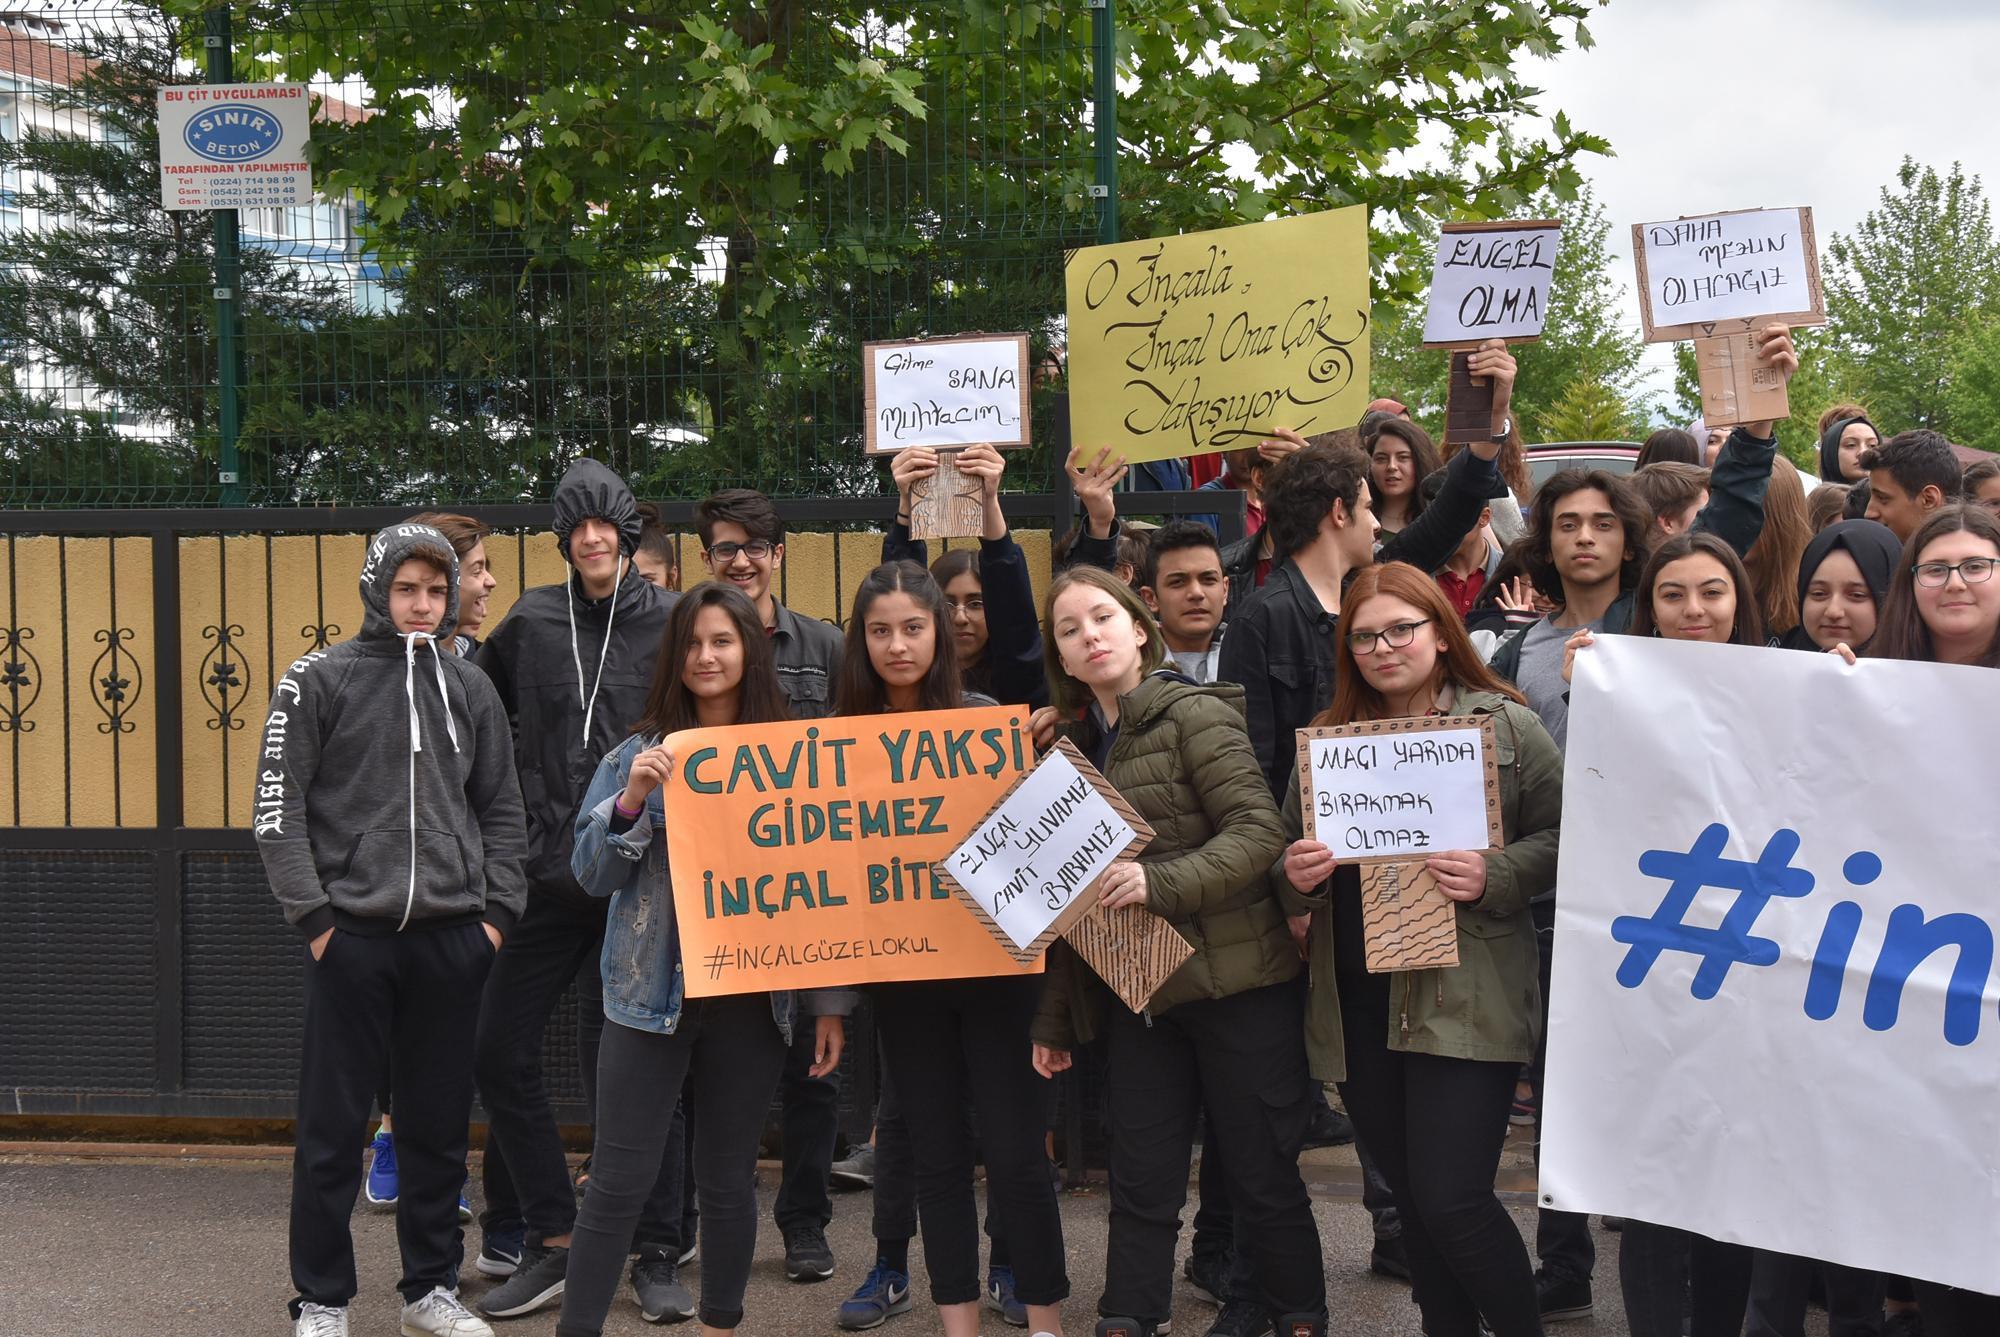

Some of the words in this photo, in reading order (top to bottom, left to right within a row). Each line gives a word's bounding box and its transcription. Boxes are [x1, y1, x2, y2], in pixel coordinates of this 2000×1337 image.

[165, 91, 183, 101] BU
[188, 88, 208, 103] ÇİT
[213, 88, 302, 100] UYGULAMASI
[200, 112, 266, 132] SINIR
[207, 141, 261, 156] BETON
[165, 164, 234, 174] TARAFINDAN
[239, 163, 308, 174] YAPILMIŞTIR
[210, 178, 242, 187] (0224)
[245, 177, 263, 185] 714
[283, 176, 295, 184] 99
[210, 188, 242, 197] (0542)
[245, 187, 264, 195] 242
[283, 186, 295, 194] 48
[210, 198, 242, 207] (0535)
[1650, 219, 1721, 247] DAHA
[1443, 235, 1551, 272] ENGEL
[1085, 259, 1119, 310] O
[1458, 285, 1538, 327] OLMA
[1220, 311, 1278, 362] Ona
[884, 351, 934, 376] Gitme
[949, 366, 1016, 389] SANA
[264, 710, 288, 760] and
[683, 726, 857, 795] CAVİT
[878, 717, 1025, 784] YAKŞİ
[1393, 740, 1475, 771] YARIDA
[254, 769, 285, 836] Rise
[1014, 775, 1095, 858] YUVAMIZ
[1317, 791, 1433, 817] BIRAKMAK
[747, 796, 949, 848] GİDEMEZ
[1345, 826, 1430, 850] OLMAZ
[703, 869, 848, 919] İNÇAL
[867, 856, 949, 904] BİTE
[1611, 822, 2000, 1047] #in
